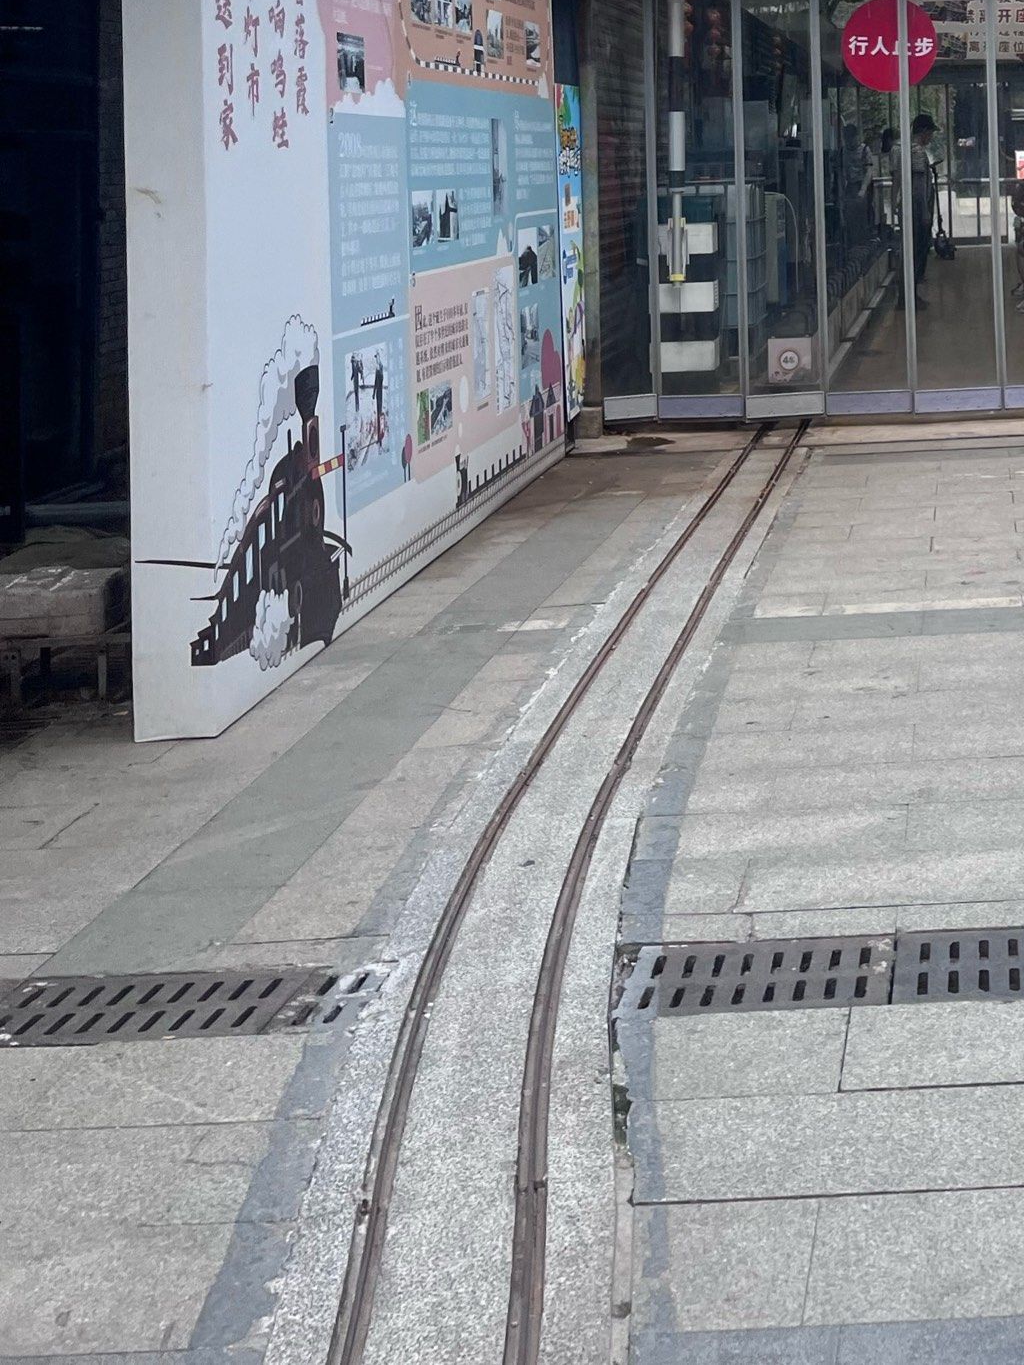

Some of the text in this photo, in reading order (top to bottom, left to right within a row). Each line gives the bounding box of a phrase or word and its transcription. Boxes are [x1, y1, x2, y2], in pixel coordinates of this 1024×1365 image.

[848, 35, 934, 57] 行人止步
[969, 41, 1024, 53] 离座位
